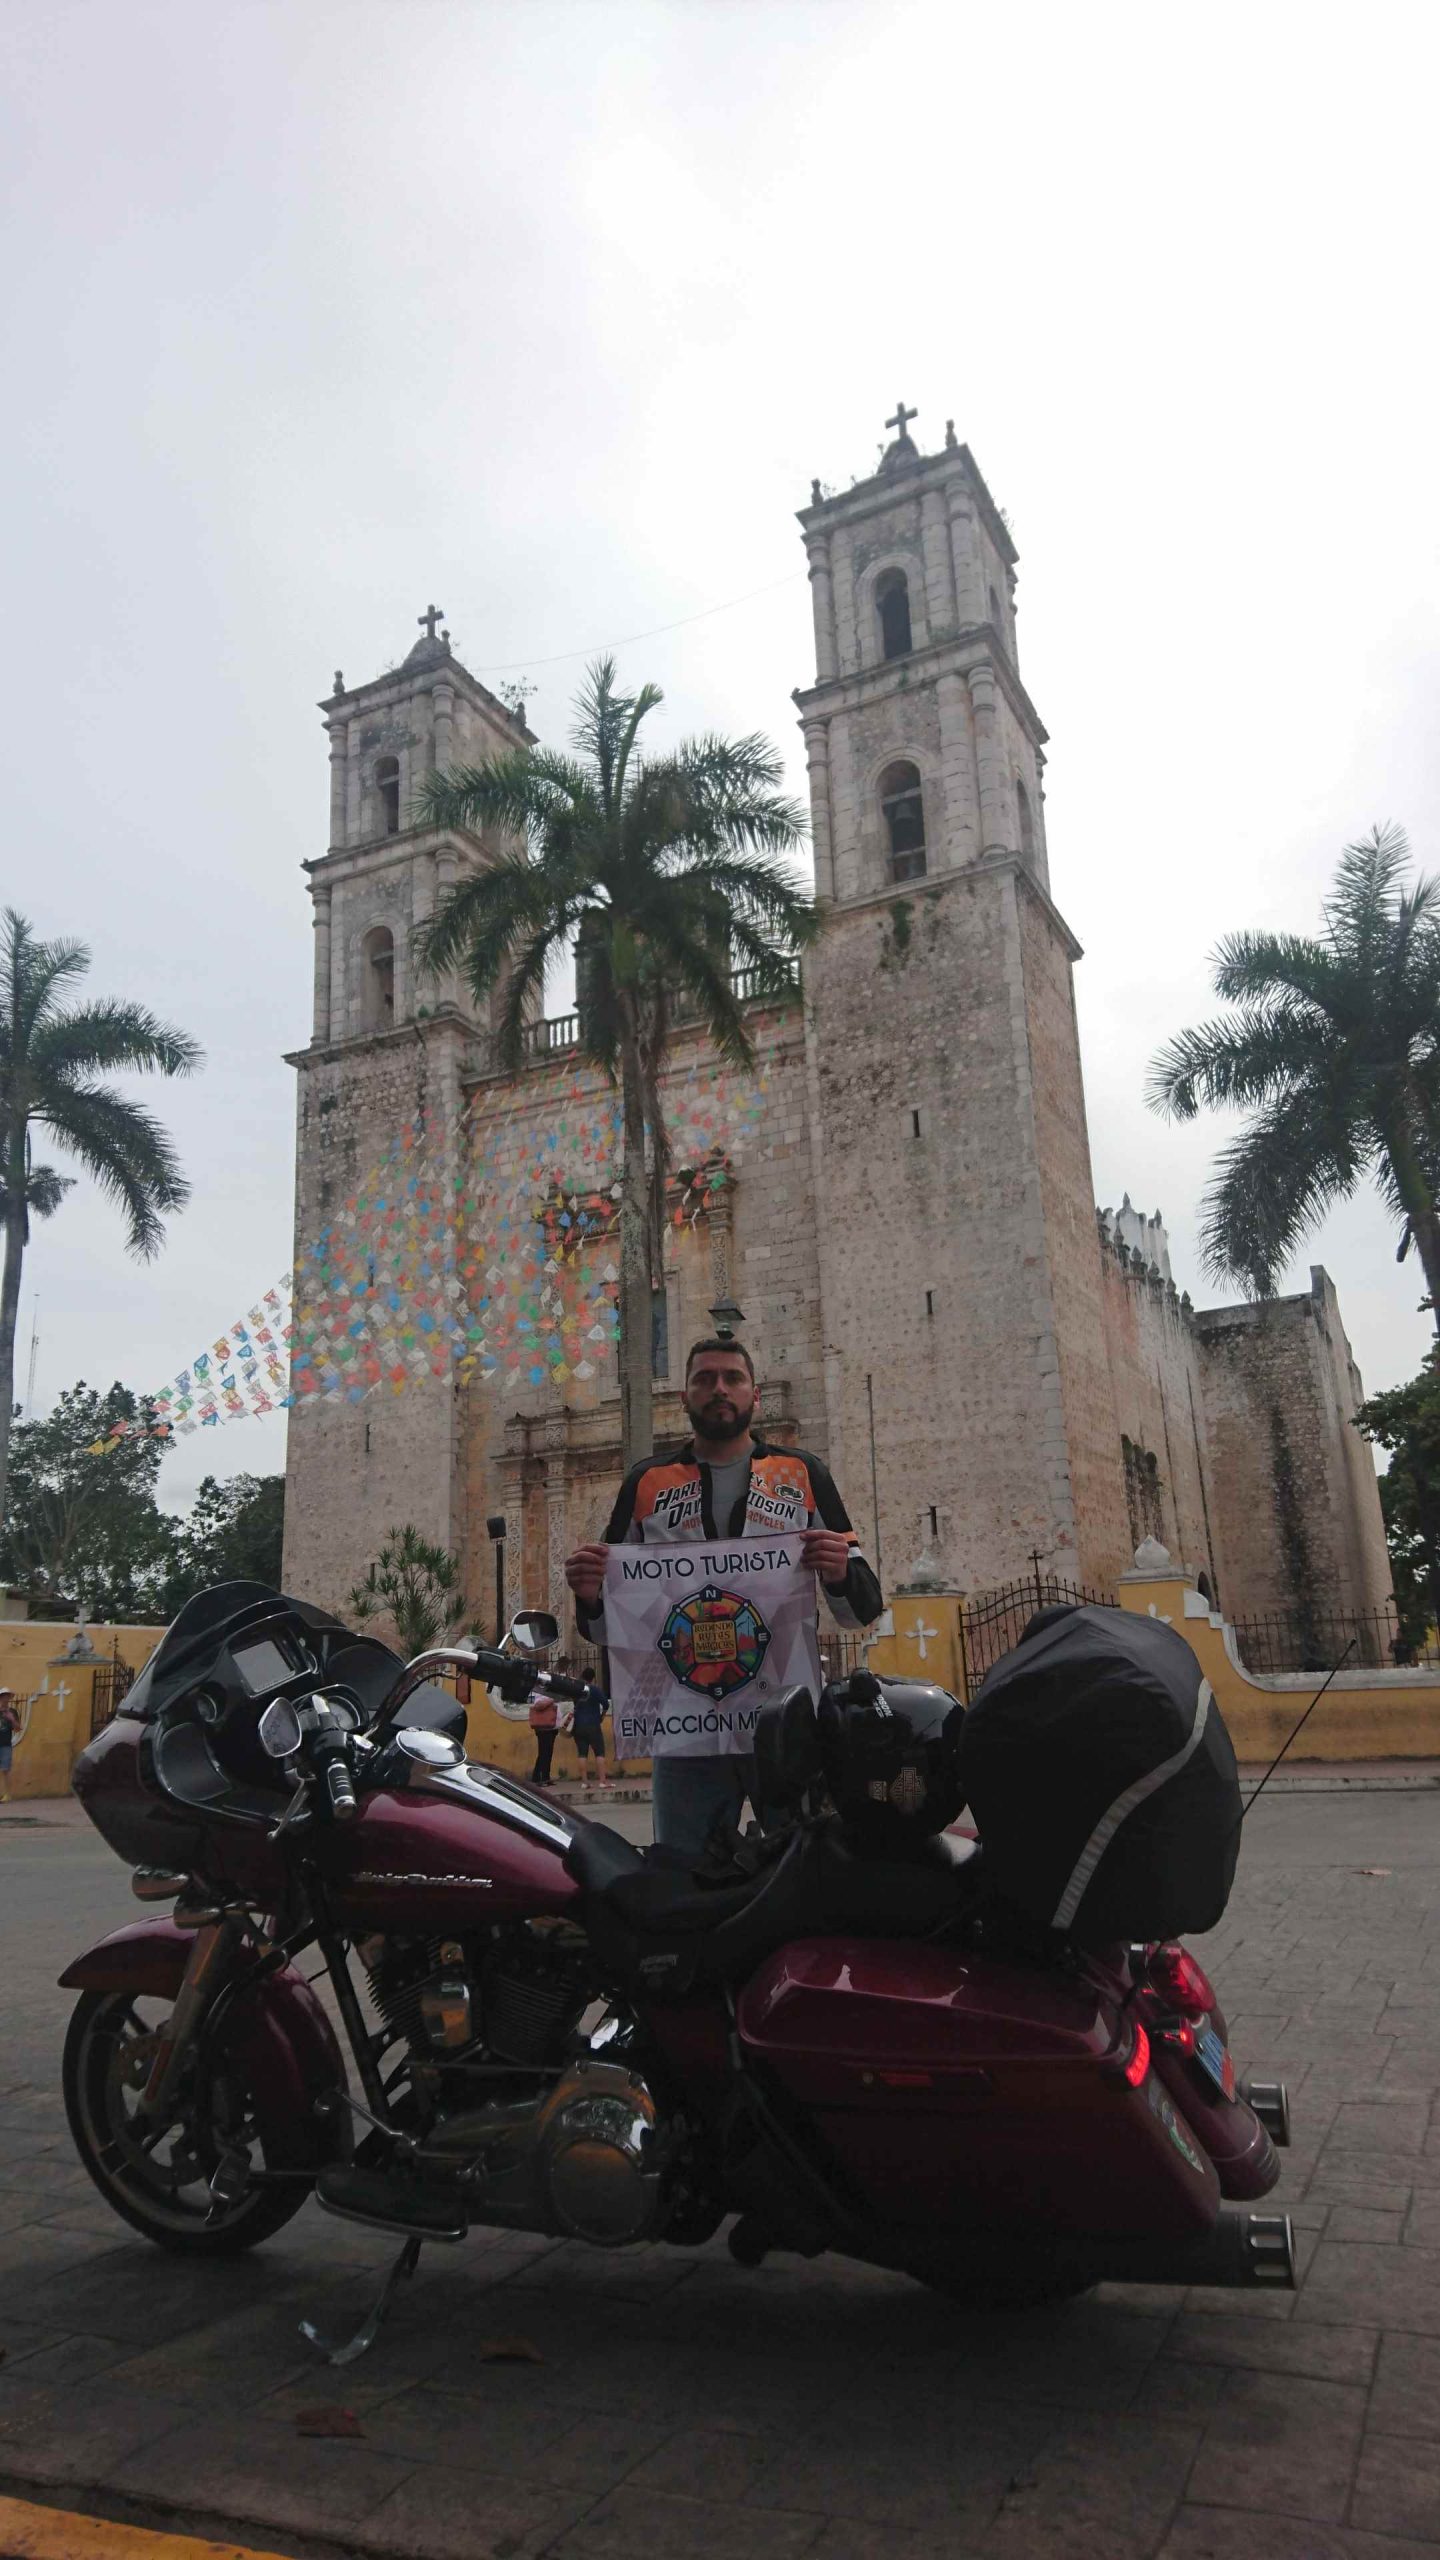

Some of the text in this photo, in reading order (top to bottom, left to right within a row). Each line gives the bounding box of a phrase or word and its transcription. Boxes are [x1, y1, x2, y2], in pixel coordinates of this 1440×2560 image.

[622, 1550, 791, 1580] MOTO TURISTA
[705, 1589, 717, 1599] N
[758, 1632, 769, 1642] E
[661, 1639, 672, 1649] O
[714, 1687, 723, 1696] S
[621, 1718, 647, 1737] EN
[652, 1708, 733, 1736] ACCIÓN
